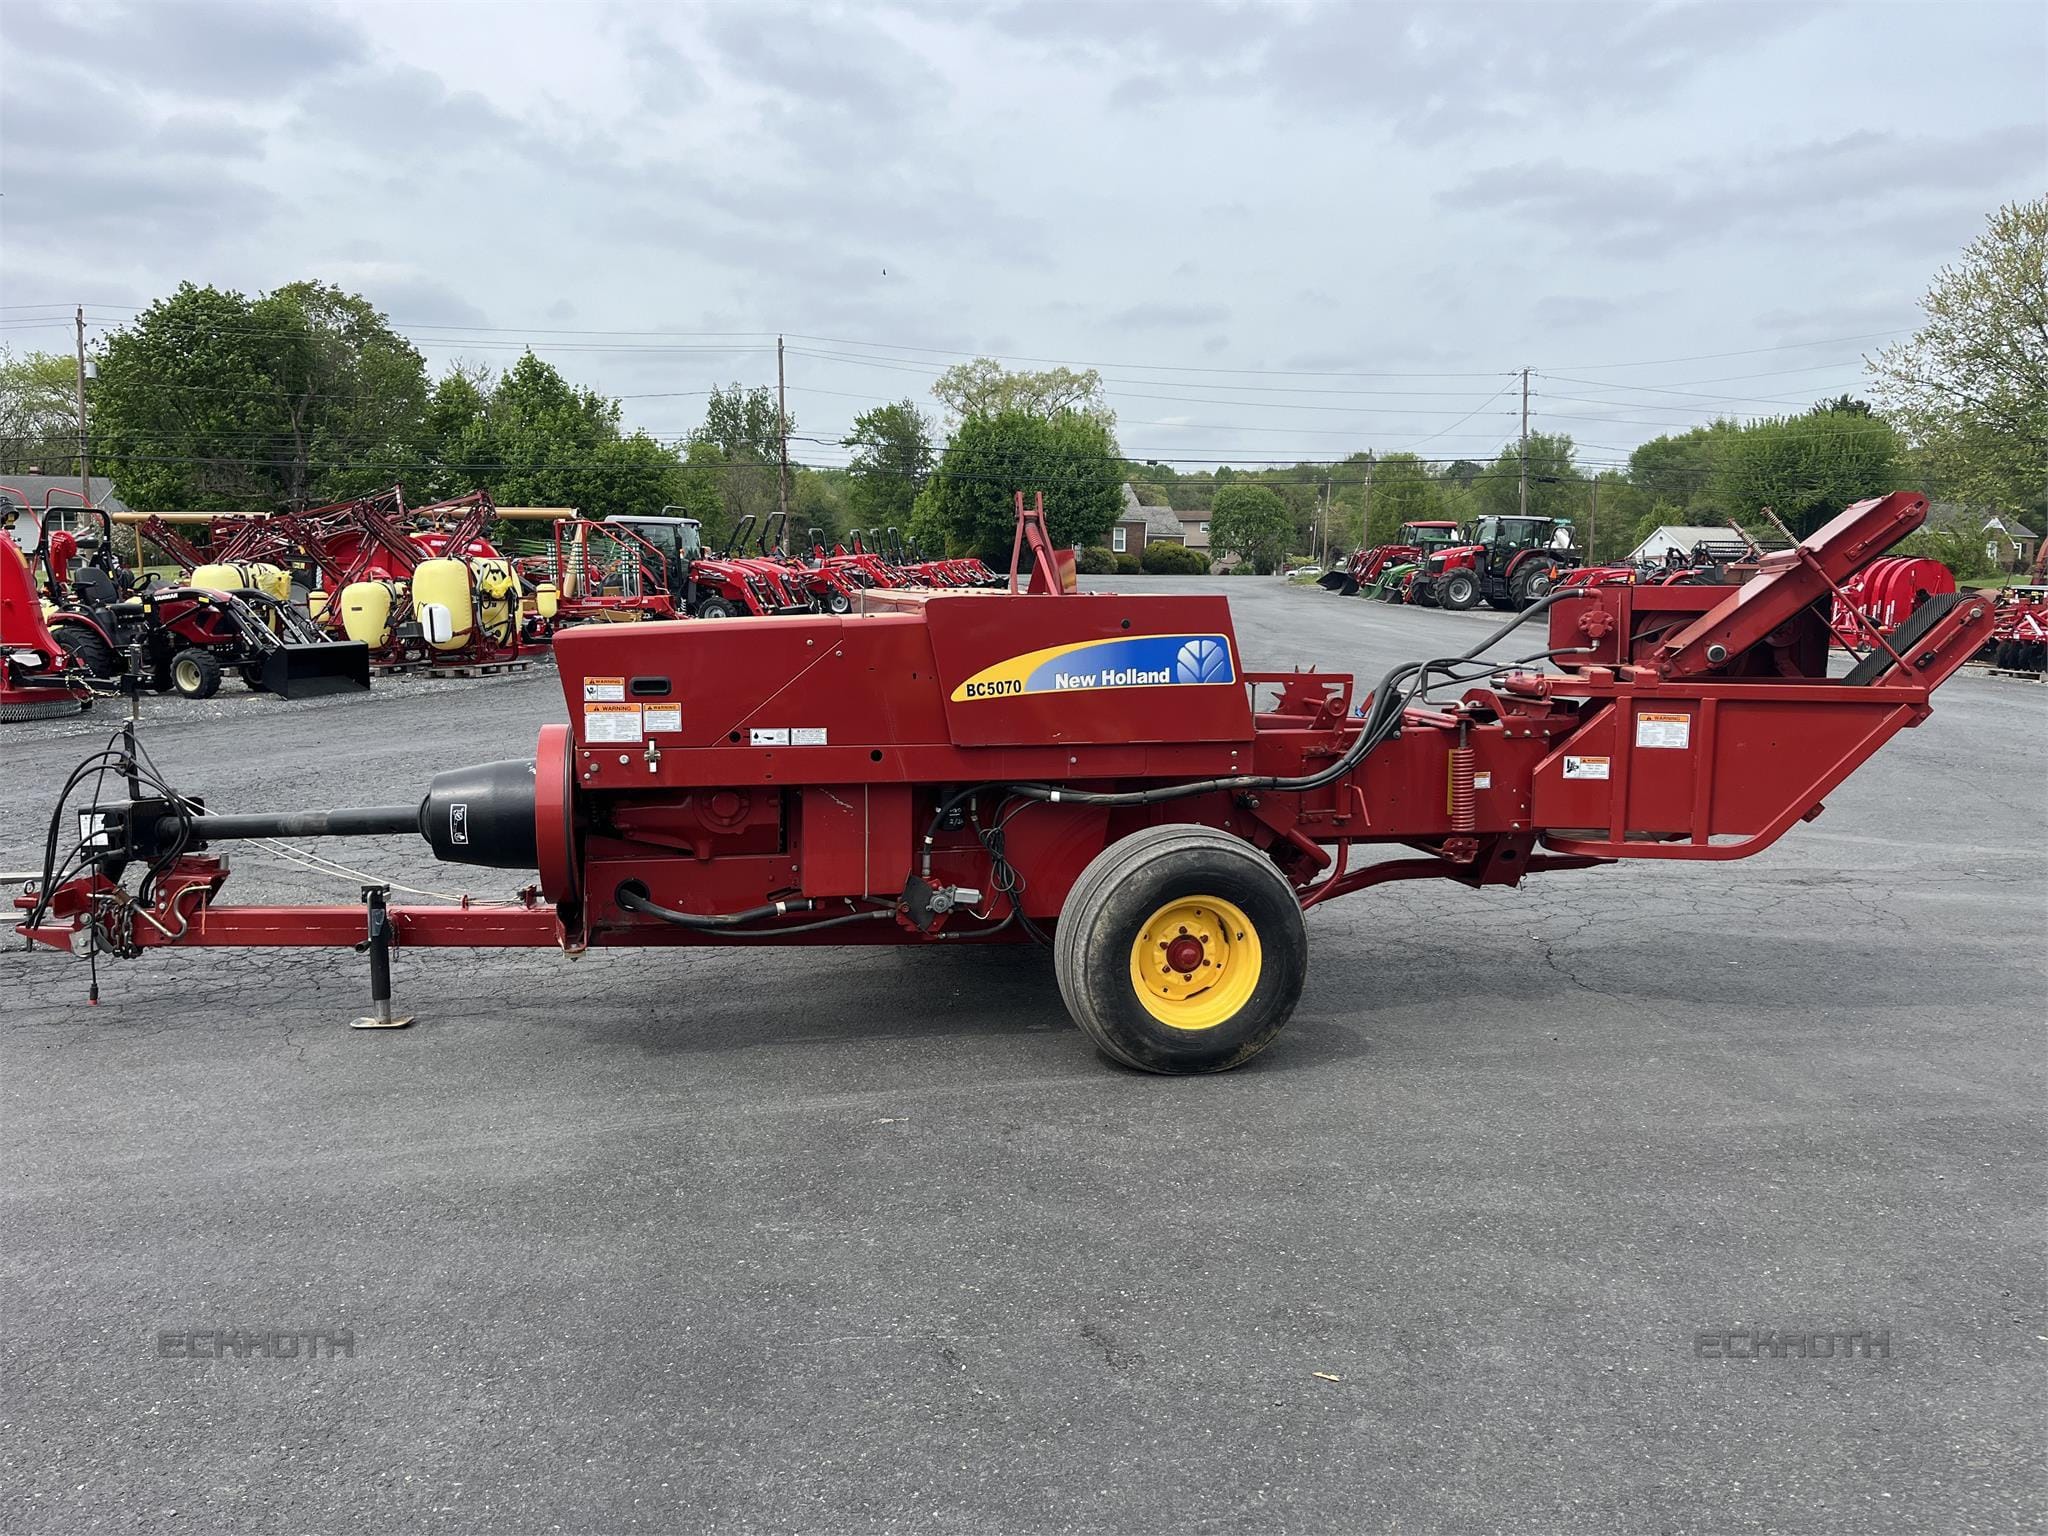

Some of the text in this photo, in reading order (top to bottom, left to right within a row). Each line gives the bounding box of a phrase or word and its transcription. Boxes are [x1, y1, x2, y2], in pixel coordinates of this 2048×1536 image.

[1055, 667, 1170, 689] New Holland
[966, 680, 1022, 697] BC5070
